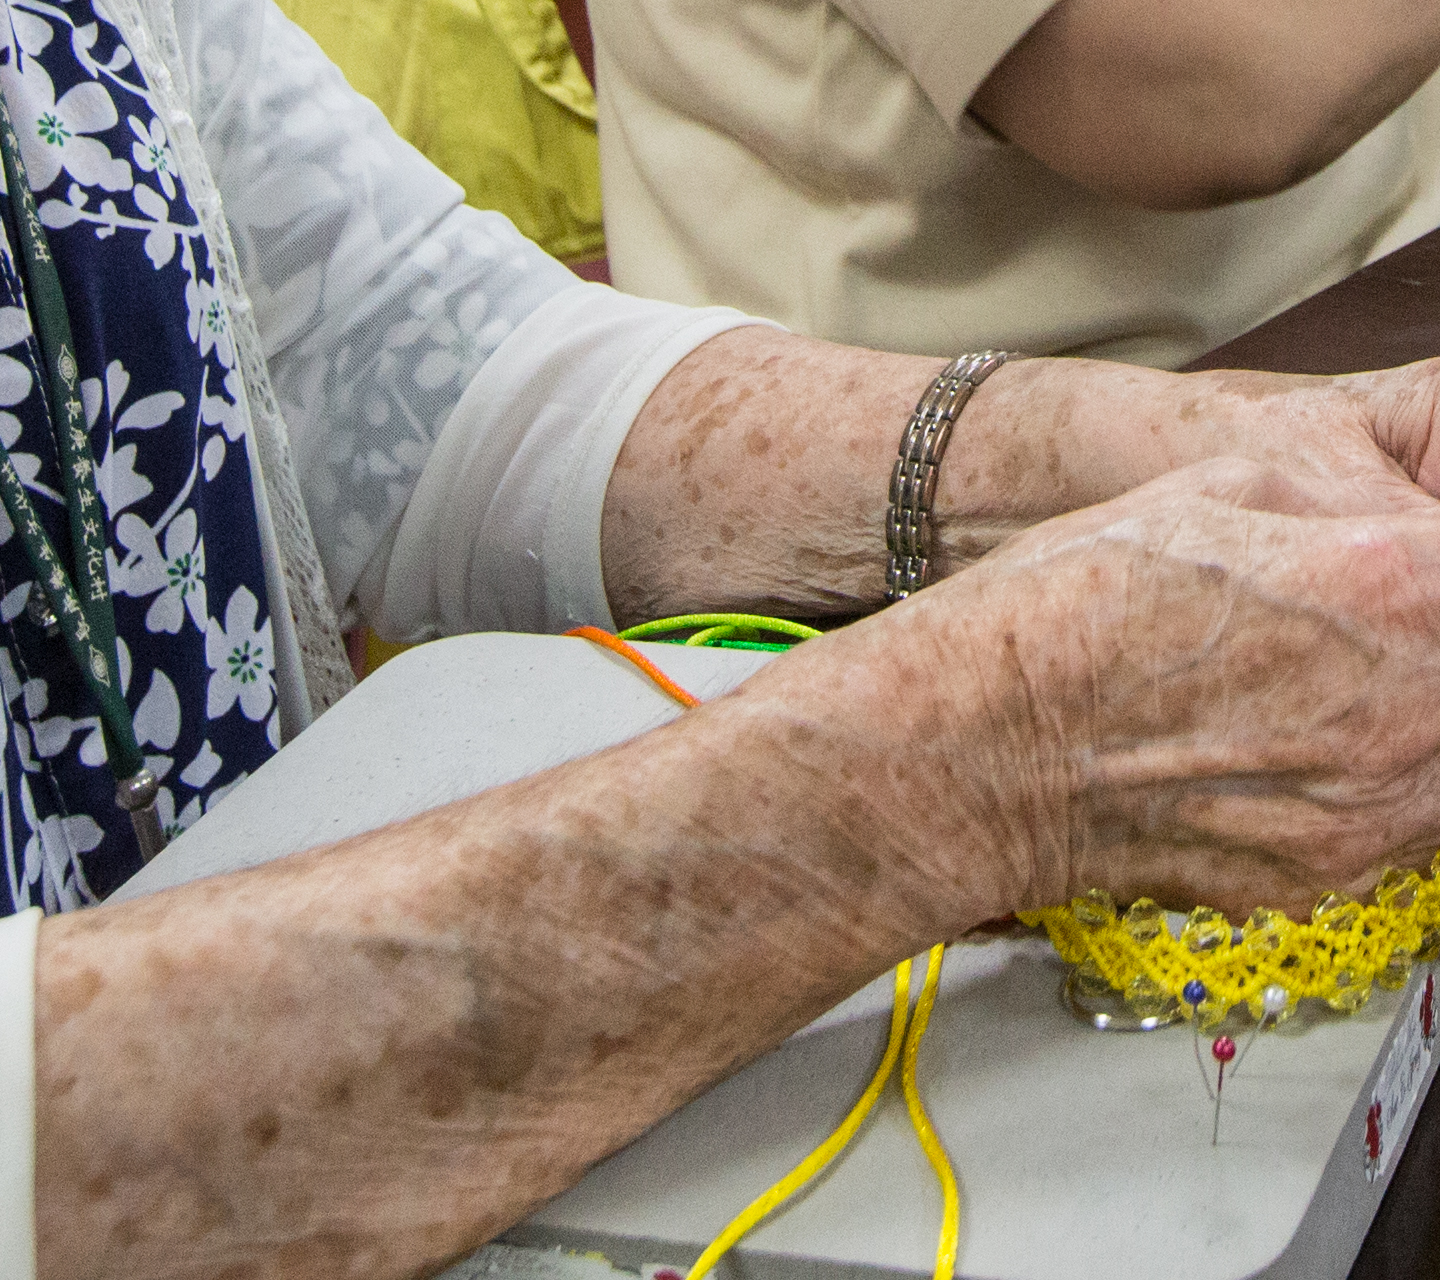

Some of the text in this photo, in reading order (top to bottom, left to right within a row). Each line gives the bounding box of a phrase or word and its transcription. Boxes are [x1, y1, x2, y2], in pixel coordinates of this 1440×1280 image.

[1, 460, 91, 642] 長庚養生文化村
[64, 397, 109, 602] 長庚養生文化村
